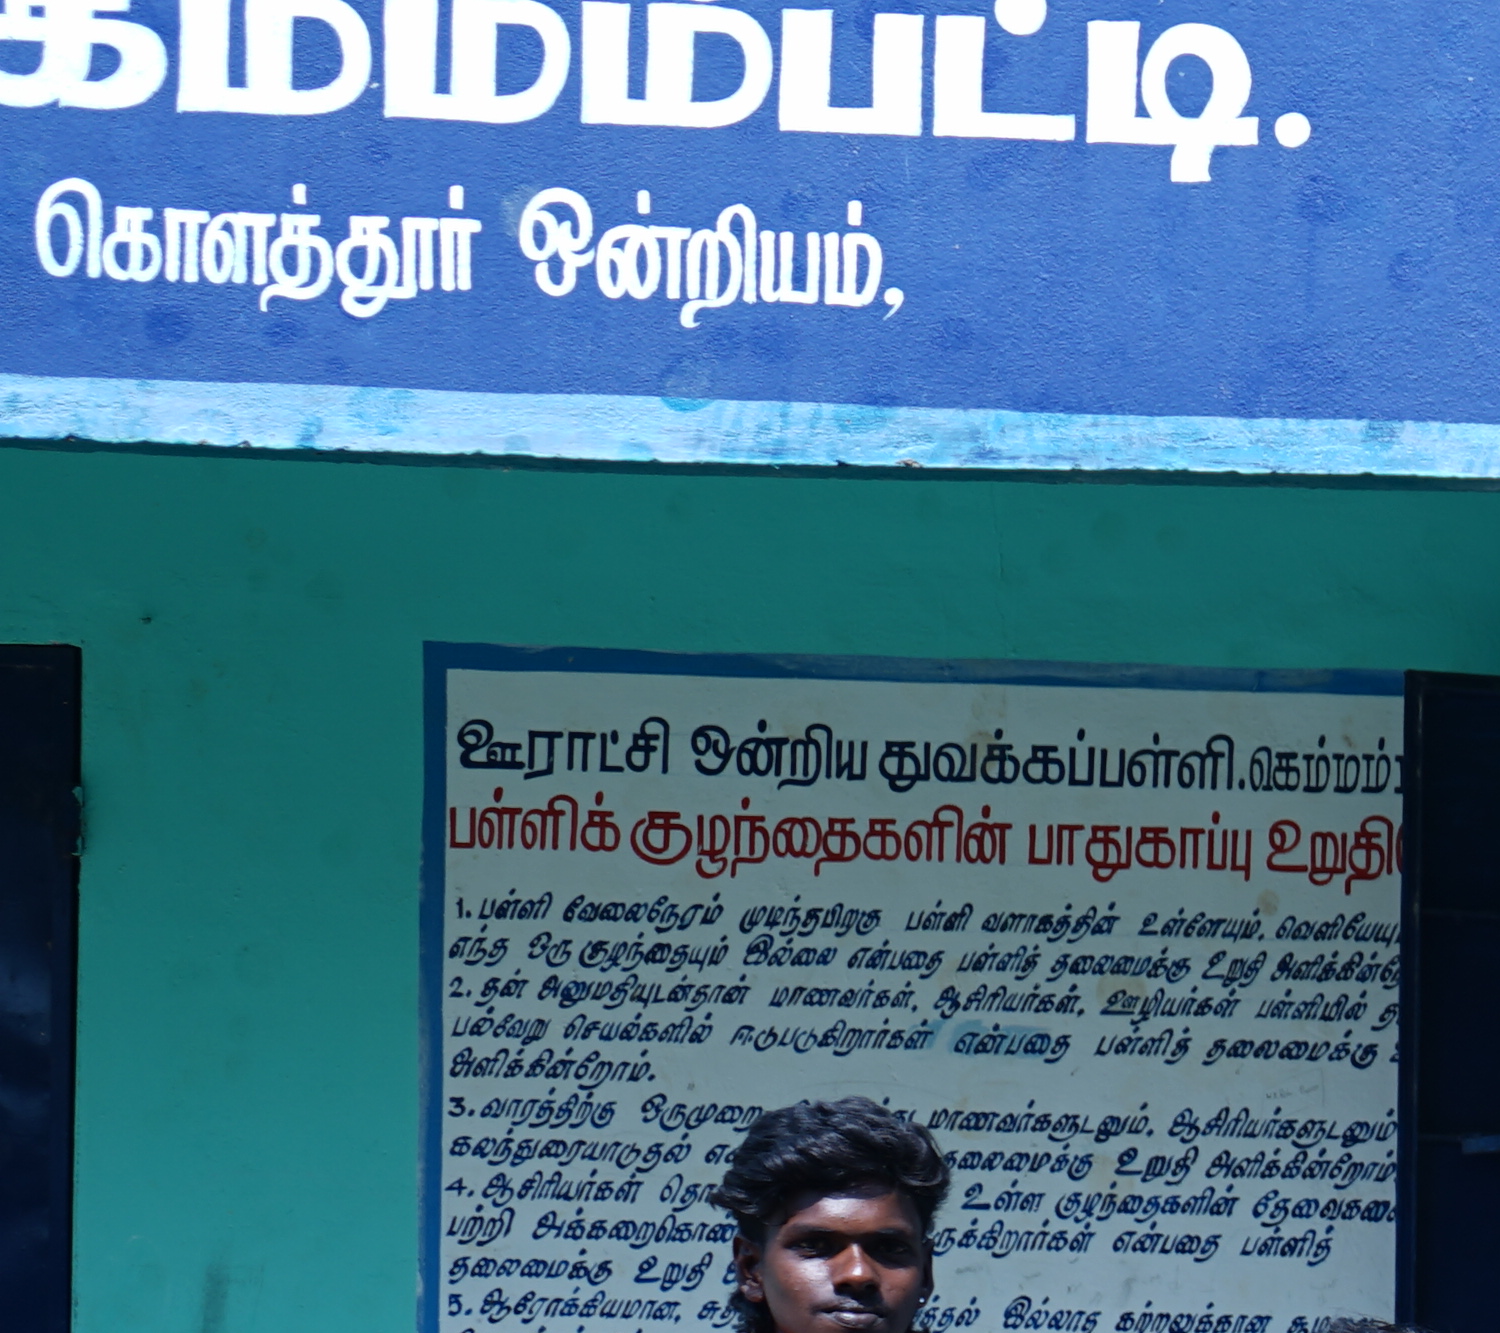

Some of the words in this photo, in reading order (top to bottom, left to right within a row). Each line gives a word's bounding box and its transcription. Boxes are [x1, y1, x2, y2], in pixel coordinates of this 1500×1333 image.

[35, 178, 483, 319] கொளத்தூர்
[516, 187, 906, 329] ஒன்றியம்,
[457, 717, 670, 780] ஊராட்சி
[690, 719, 868, 791] ஒன்றிய
[449, 787, 621, 853] பள்ளிக்
[630, 797, 1012, 879] குழந்தைகளின்
[1028, 811, 1253, 882] பாதுகாப்பு
[477, 888, 552, 921] பள்ளி
[905, 899, 973, 932] பள்ளி
[981, 901, 1121, 943] வளாகத்தின்
[448, 924, 510, 966] எந்த
[528, 931, 573, 968] ஒரு
[578, 931, 730, 973] குழந்தையும்
[743, 933, 838, 968] இல்லை
[848, 939, 945, 979] என்பதை
[957, 942, 1042, 981] பள்ளித்
[1045, 946, 1191, 983] தலைமைக்கு
[1201, 950, 1267, 988] உறுதி
[474, 968, 529, 1007] தன்
[1100, 985, 1242, 1025] ஊழியர்கள்
[452, 1005, 552, 1045] பல்வேறு
[563, 1012, 713, 1045] செயல்களில்
[953, 1022, 1072, 1063] என்பதை
[1094, 1026, 1192, 1065] பள்ளித்
[1201, 1029, 1379, 1070] தலைமைக்கு
[480, 1087, 618, 1129] வாரத்திற்கு
[448, 1127, 692, 1173] கலந்துரையாடுதல்
[1114, 1145, 1199, 1186] உறுதி
[482, 1168, 645, 1207] ஆசிரியர்கள்
[960, 1178, 1046, 1213] உள்ள
[1055, 1181, 1240, 1223] குழந்தைகளின்
[447, 1203, 516, 1247] பற்றி
[1112, 1220, 1223, 1263] என்பதை
[1240, 1224, 1335, 1267] பள்ளித்
[448, 1249, 613, 1285] தலைமைக்கு
[633, 1252, 713, 1292] உறுதி
